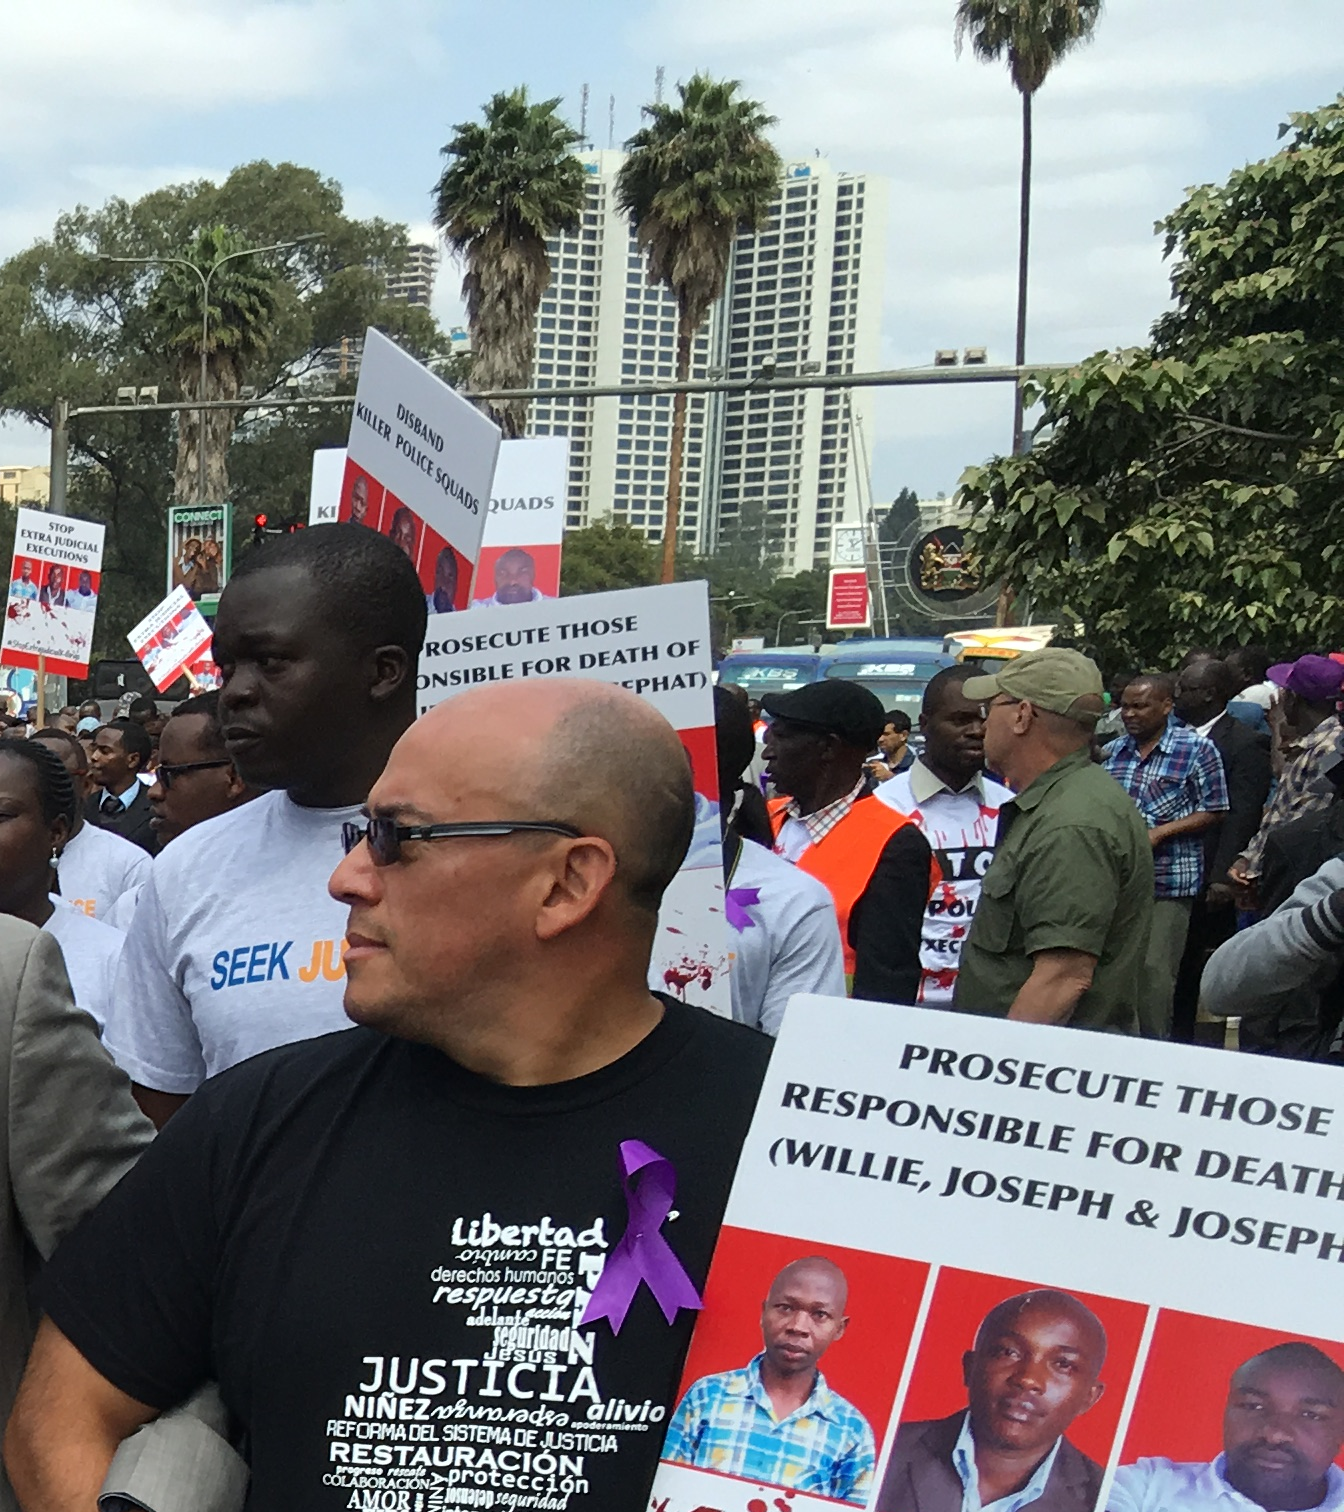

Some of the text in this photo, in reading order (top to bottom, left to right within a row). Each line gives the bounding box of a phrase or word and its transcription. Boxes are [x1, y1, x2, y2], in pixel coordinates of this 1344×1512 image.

[397, 403, 444, 453] DISBAND
[356, 402, 479, 515] KILLER POLICE SQUADS
[174, 510, 222, 523] CONNECT
[487, 496, 554, 514] QUADS
[21, 529, 100, 553] EXTRA JUDICIAL
[48, 522, 74, 534] STOP
[26, 543, 89, 563] EXECUTIONS
[425, 616, 638, 658] ROSECUTE THOSE
[417, 639, 701, 690] ONSIBLE FOR DEATH OF
[211, 941, 294, 990] SEEK
[899, 1043, 1335, 1137] PROSECUTE THOSE
[781, 1082, 1344, 1202] RESPONSIBLE FOR DEATH
[768, 1136, 1344, 1264] (WILLIE, JOSEPH & JOSEPH
[541, 1249, 571, 1270] FE
[431, 1266, 574, 1284] derechos humanos
[433, 1283, 576, 1311] respuesta
[466, 1306, 530, 1326] adelante
[493, 1324, 571, 1352] seguridad
[359, 1356, 602, 1403] JUSTICIA
[344, 1393, 430, 1421] NIÑEZ
[586, 1399, 666, 1423] alivio
[326, 1419, 618, 1453] REFORMA DEL SISTEMA DE JUSTICIA
[571, 1421, 648, 1432] apoderamiento
[329, 1441, 584, 1477] RESTAURACIÓN
[322, 1467, 589, 1494] COLABORACIÓN protección
[346, 1489, 412, 1510] AMOR
